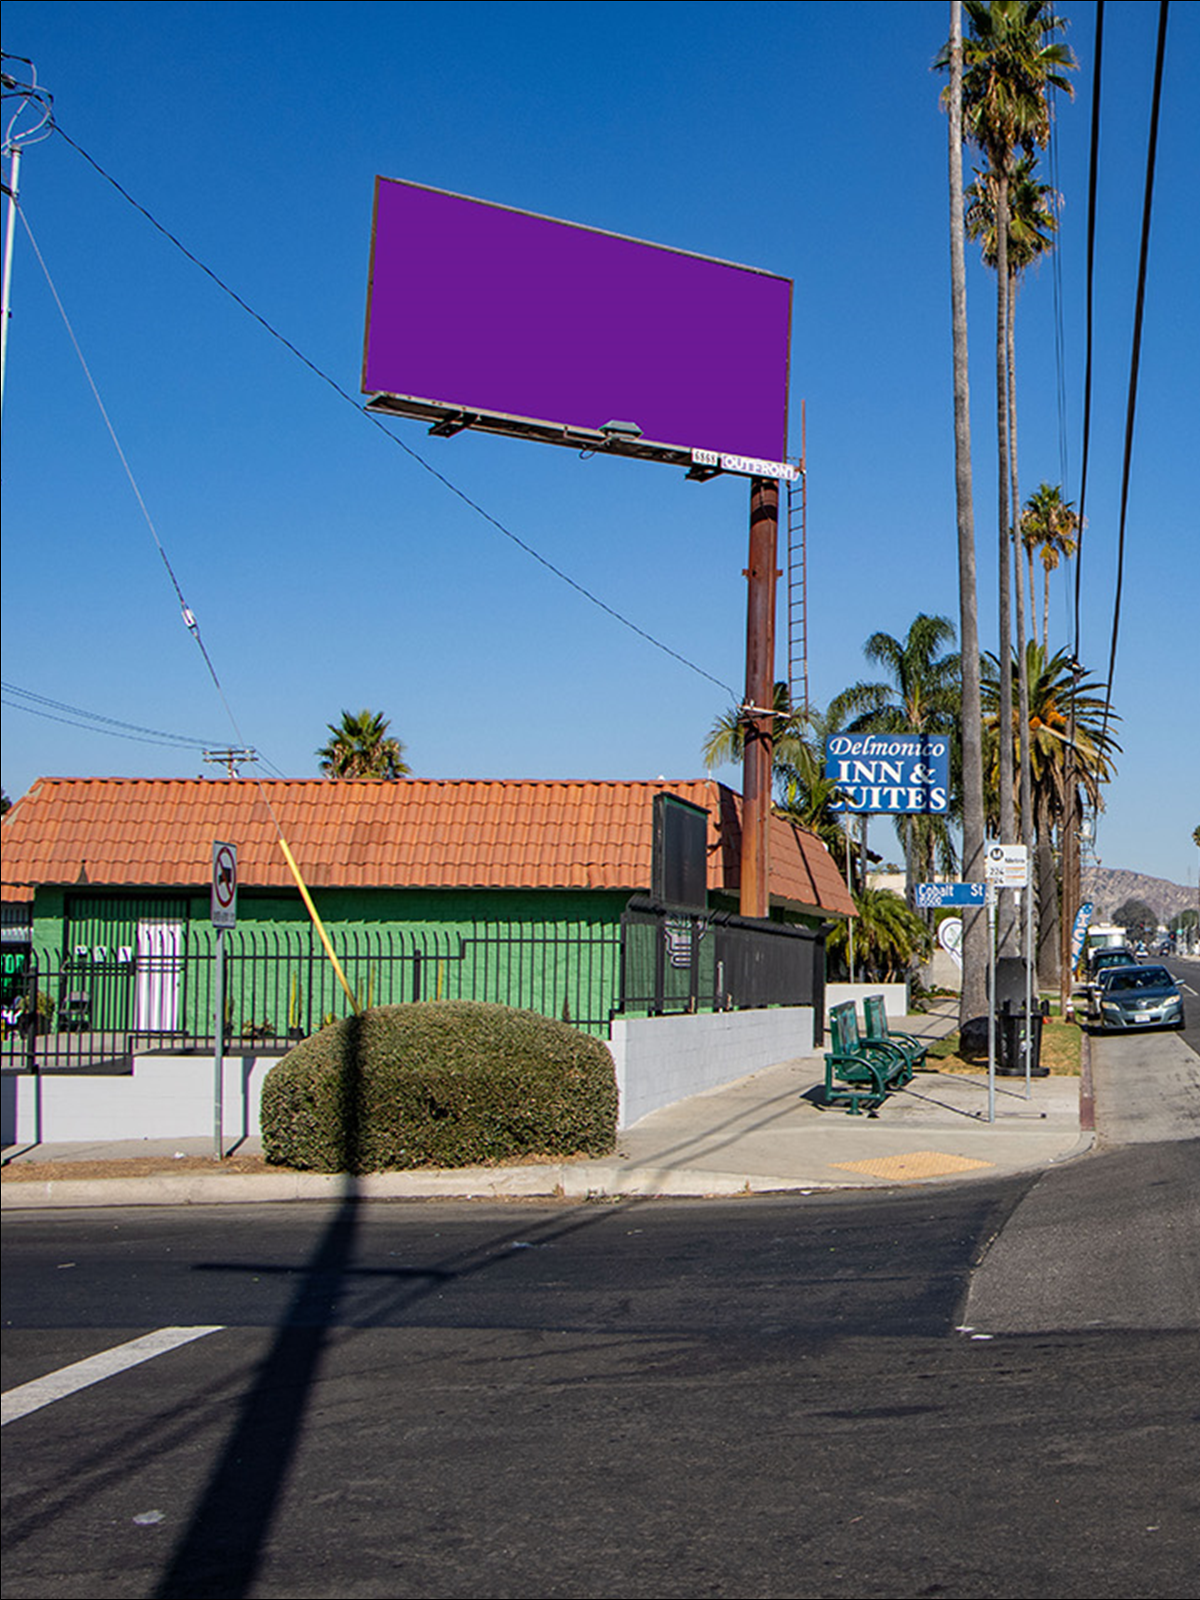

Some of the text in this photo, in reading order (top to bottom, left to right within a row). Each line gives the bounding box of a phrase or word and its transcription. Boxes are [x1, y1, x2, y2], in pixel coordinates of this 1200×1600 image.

[724, 454, 797, 480] OUTFRONT
[829, 734, 946, 758] Delmonico
[837, 760, 936, 785] INN &
[918, 883, 984, 897] Cobalt St
